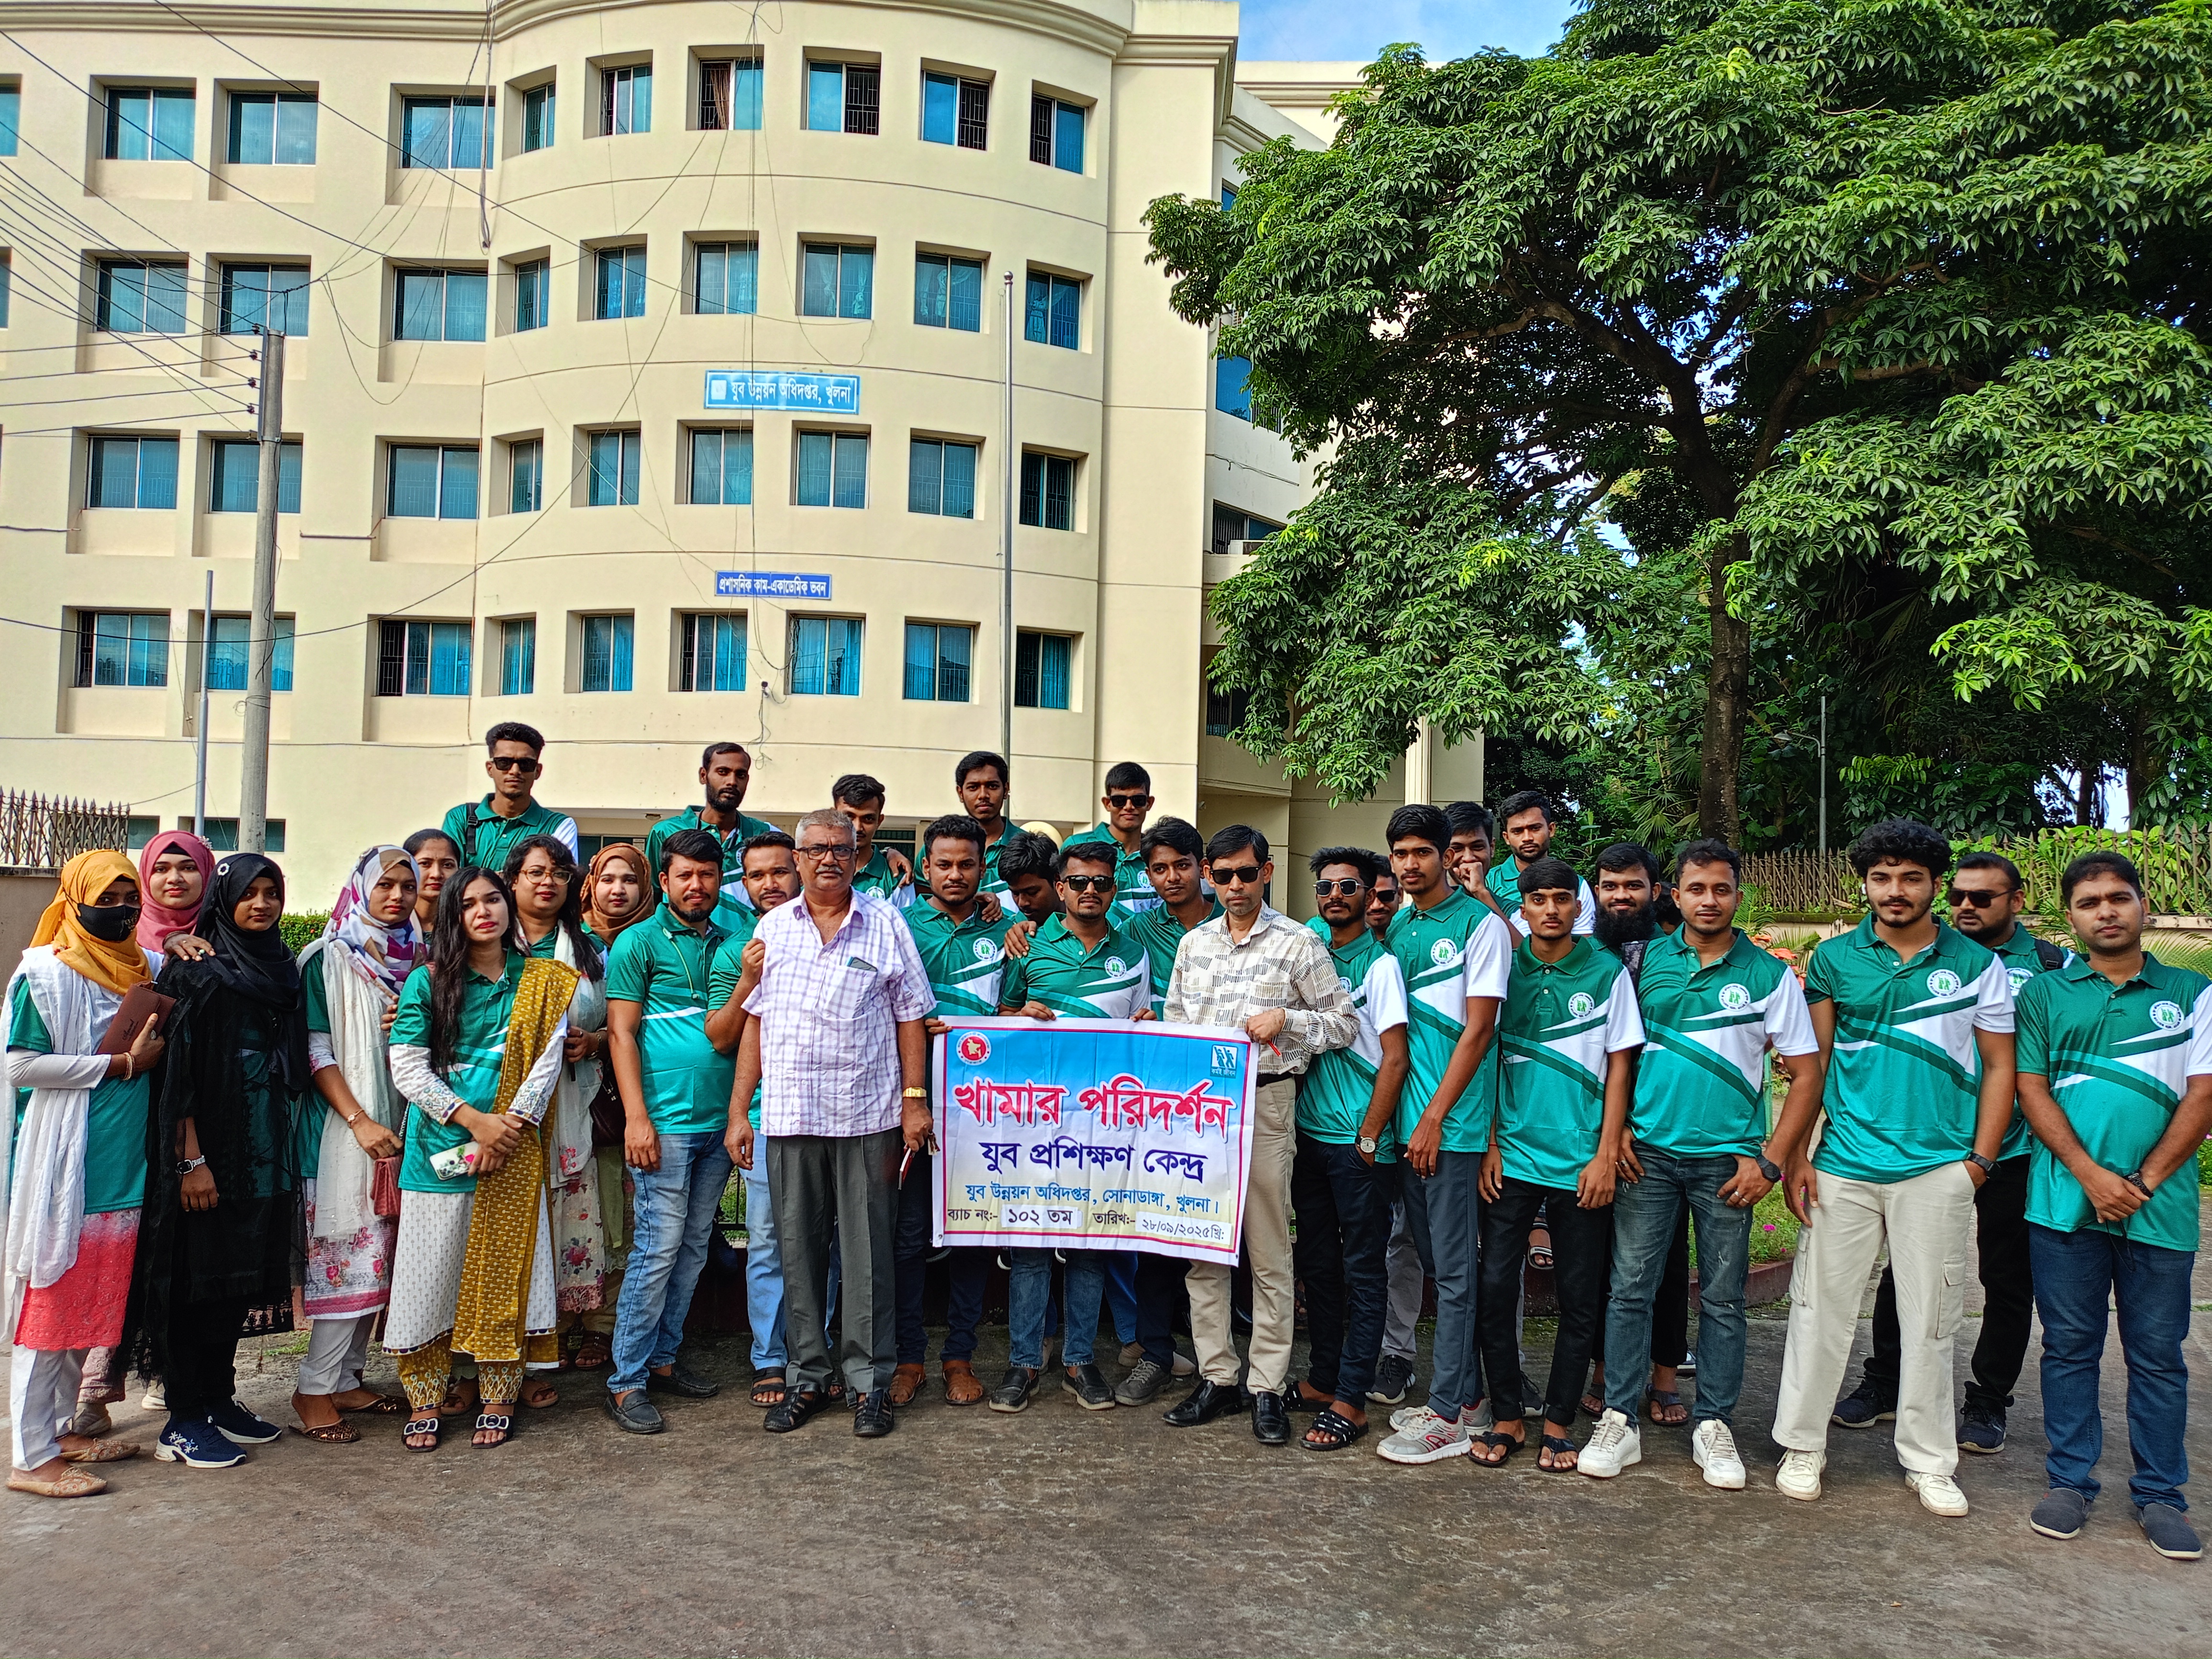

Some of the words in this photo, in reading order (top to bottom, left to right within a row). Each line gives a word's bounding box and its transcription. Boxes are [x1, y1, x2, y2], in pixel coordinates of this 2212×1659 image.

[730, 381, 745, 402] যুব
[748, 378, 776, 403] উন্নয়ন
[825, 383, 852, 406] খুলনা
[809, 581, 827, 597] ভবন
[954, 1079, 1067, 1125] খামার
[1079, 1075, 1234, 1139] পরিদর্শন
[978, 1142, 1023, 1174] যুব
[1029, 1135, 1136, 1171] প্রশিক্ষণ
[1143, 1149, 1208, 1183] কেন্দ্র
[965, 1184, 986, 1203] যুব
[990, 1181, 1031, 1202] উন্নয়ন
[947, 1208, 972, 1221] ব্যাচ
[1008, 1208, 1040, 1226] ১০২
[1047, 1209, 1073, 1225] তম
